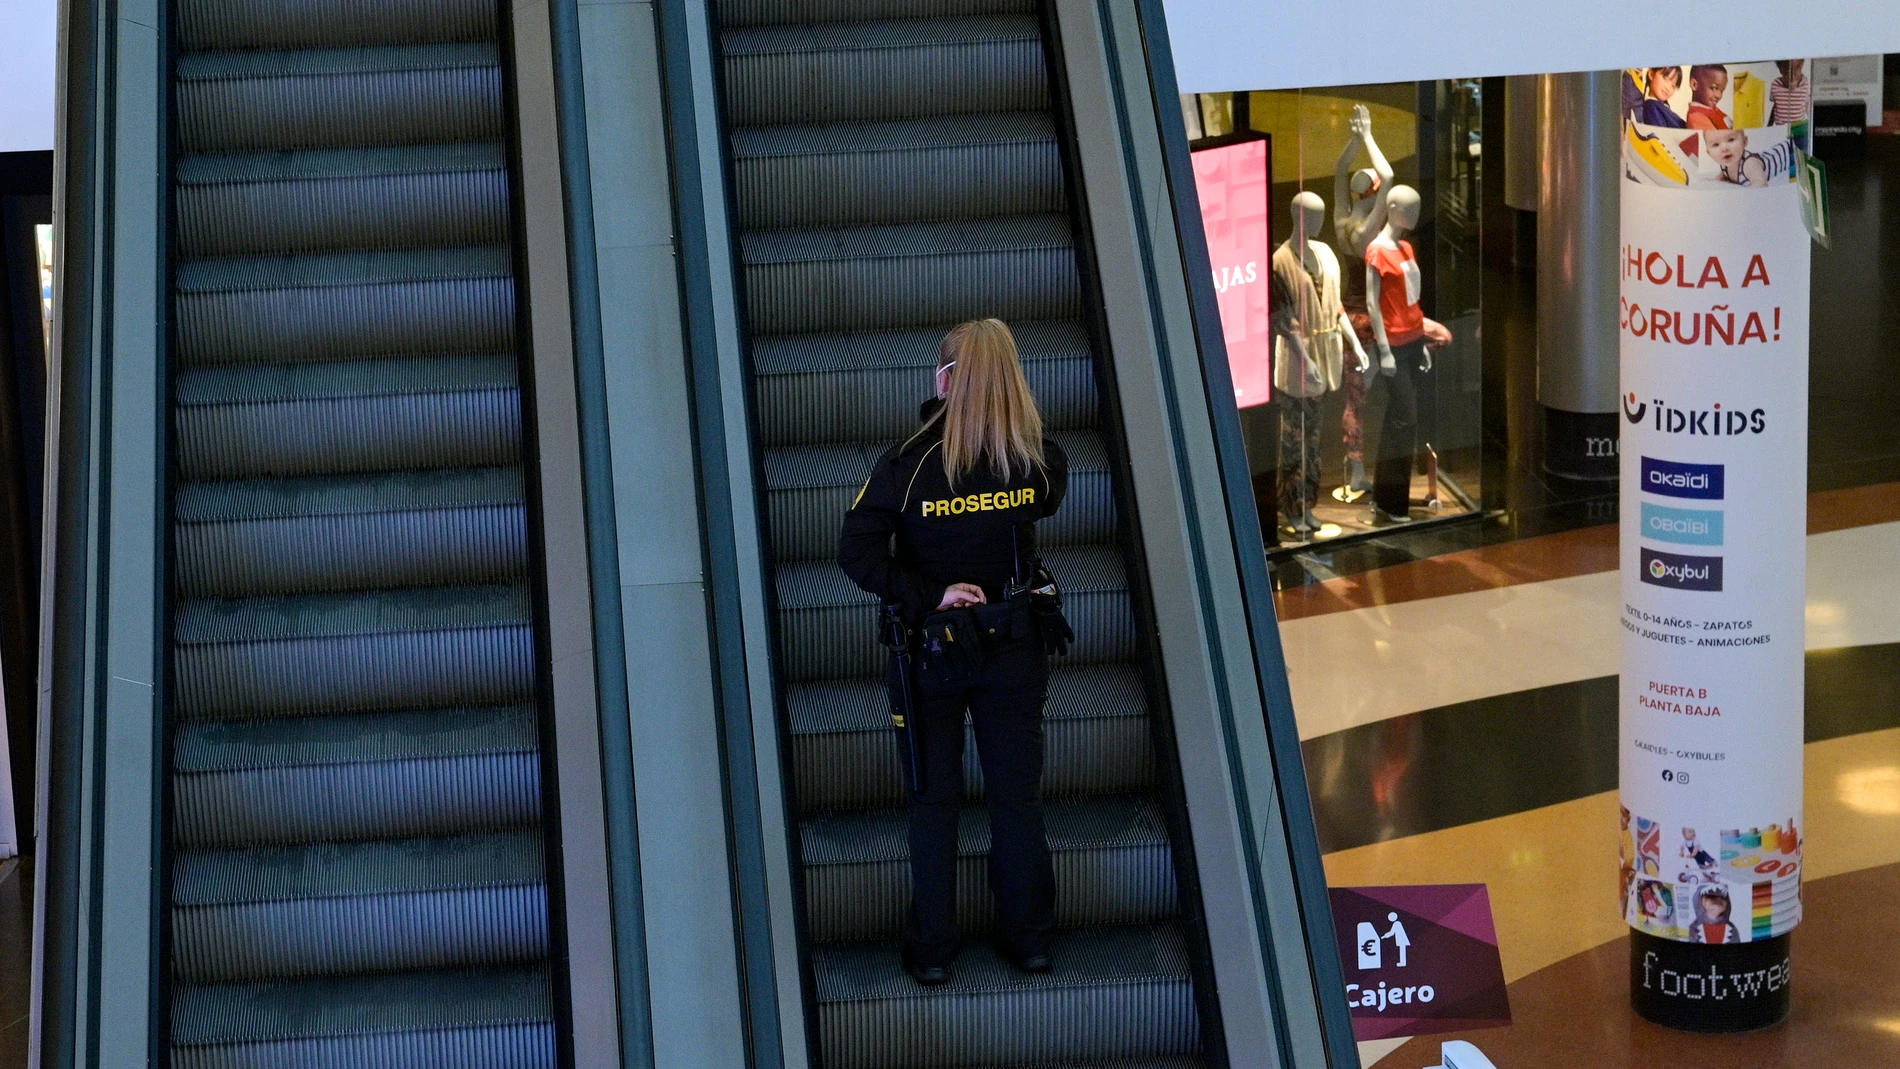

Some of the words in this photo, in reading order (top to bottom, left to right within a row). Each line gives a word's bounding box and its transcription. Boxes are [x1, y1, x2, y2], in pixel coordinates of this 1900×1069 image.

[1622, 244, 1729, 289] ¡HOLA
[1741, 254, 1770, 288] A
[1620, 296, 1781, 346] CORUÑA!
[922, 487, 1036, 517] PROSEGUR
[1625, 603, 1642, 620] TEXTIL
[1643, 612, 1661, 624] 0-14
[1663, 616, 1692, 629] AÑOS
[1703, 620, 1753, 630] ZAPATOS
[1641, 629, 1687, 645] JUGUETES
[1697, 634, 1771, 647] ANIMACIONES
[1649, 681, 1695, 699] PUERTA
[1698, 689, 1707, 699] B
[1639, 695, 1682, 714] PLANTA
[1685, 705, 1721, 717] BAJA
[1345, 981, 1435, 1012] Cajero
